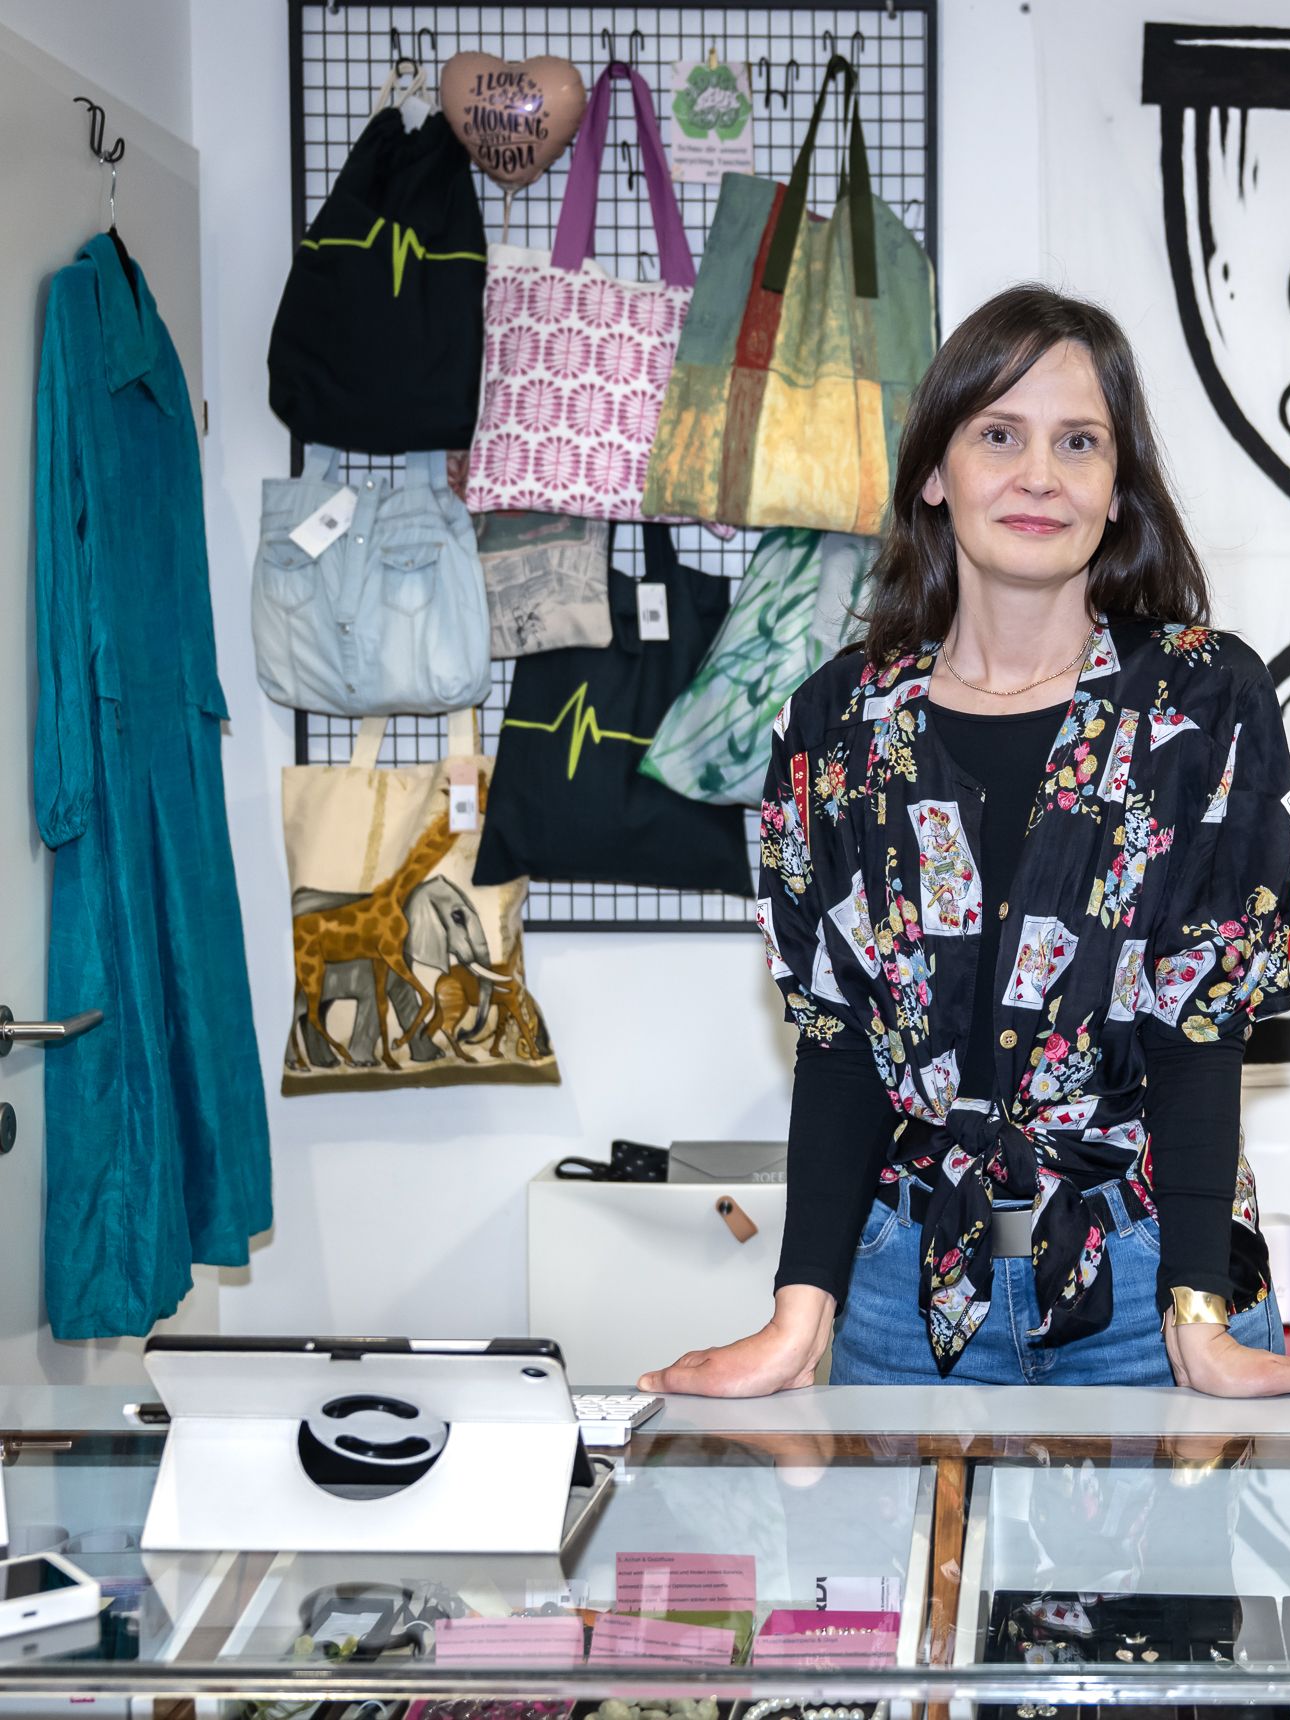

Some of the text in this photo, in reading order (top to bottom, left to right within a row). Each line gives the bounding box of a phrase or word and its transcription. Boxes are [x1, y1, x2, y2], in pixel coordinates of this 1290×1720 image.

[476, 72, 530, 96] I LOVE
[463, 105, 549, 140] MOMENT
[478, 144, 535, 174] YOU
